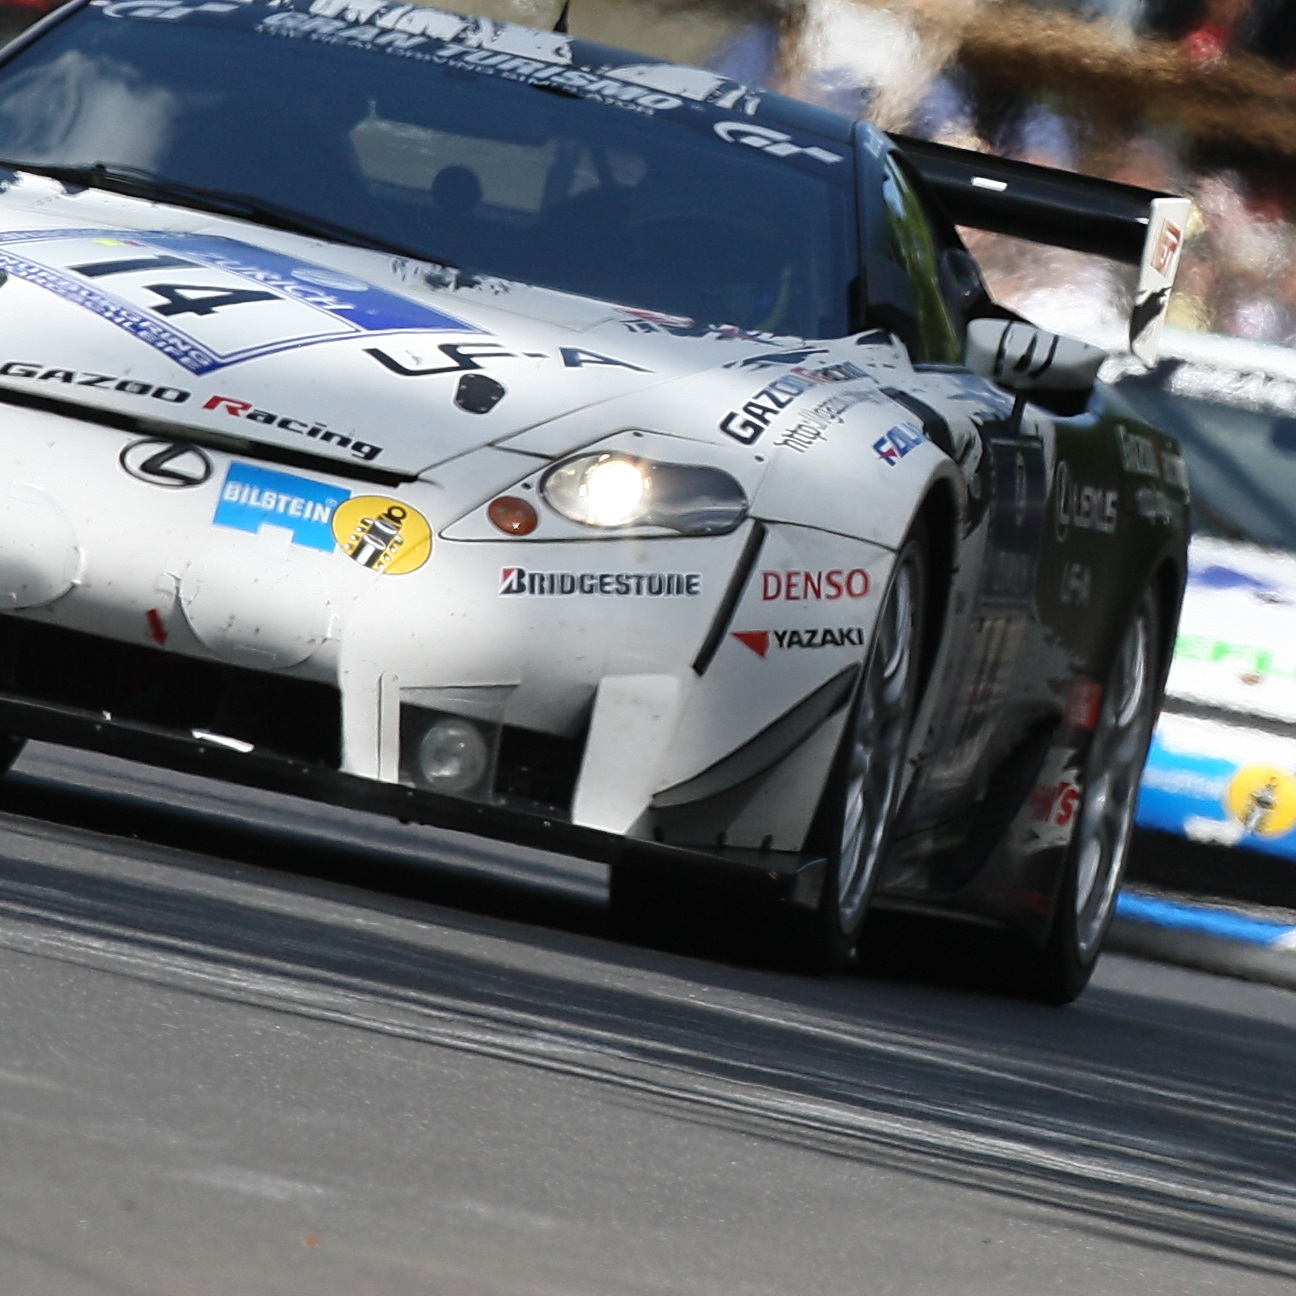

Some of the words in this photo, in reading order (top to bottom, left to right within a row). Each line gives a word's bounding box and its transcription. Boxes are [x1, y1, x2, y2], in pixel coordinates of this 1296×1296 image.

[262, 11, 429, 50] GRAN
[435, 42, 684, 110] TURISMO
[65, 254, 288, 317] 14
[203, 394, 385, 463] Racing
[224, 480, 333, 525] BILSTEIN
[500, 567, 701, 597] BRIDGESTONE
[762, 568, 871, 602] DENSO
[773, 627, 864, 649] YAZAKI
